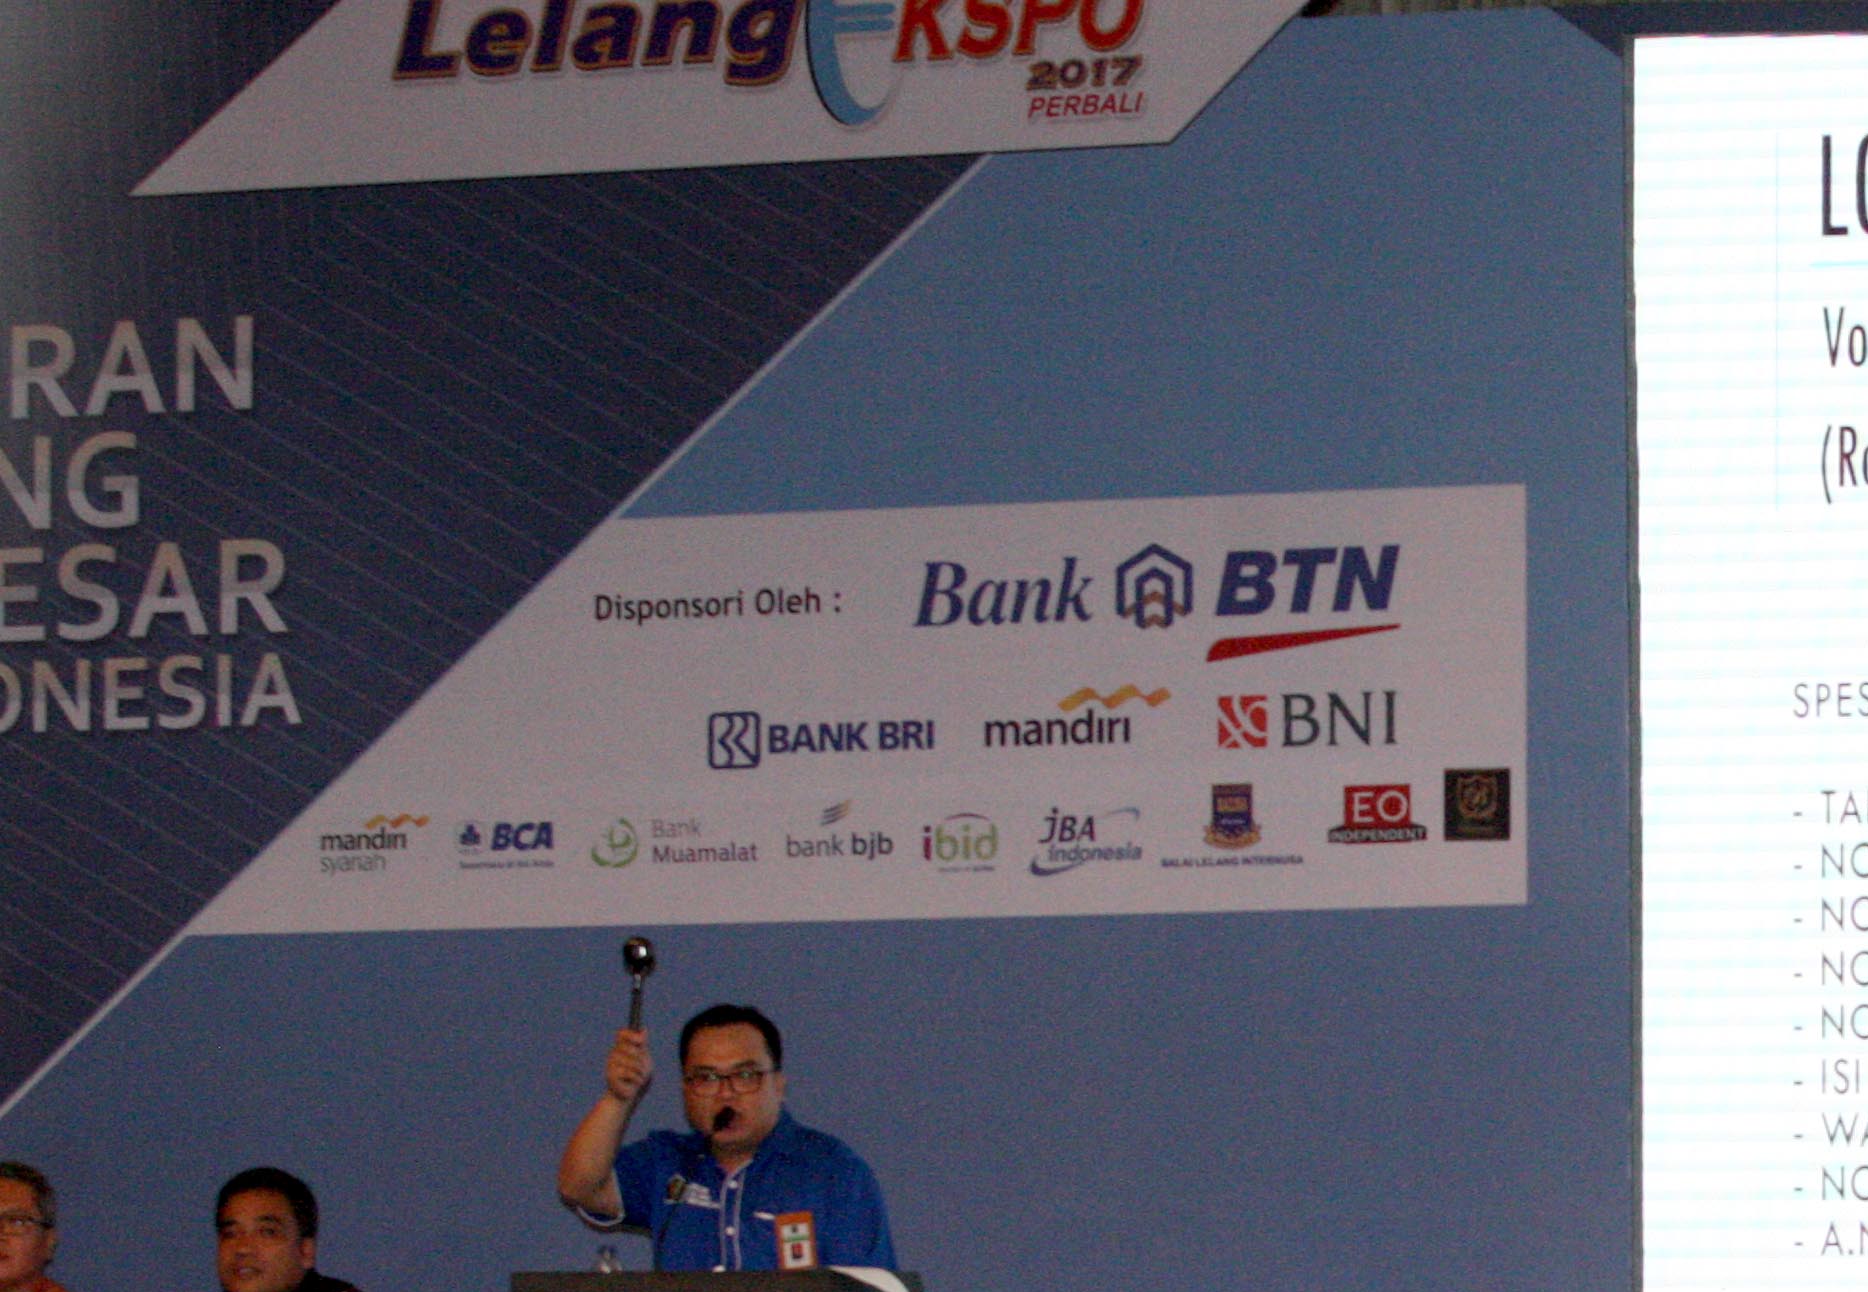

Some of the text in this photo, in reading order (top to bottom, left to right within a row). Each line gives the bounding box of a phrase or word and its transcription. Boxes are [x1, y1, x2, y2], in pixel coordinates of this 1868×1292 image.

[1027, 54, 1142, 91] 2017
[1028, 91, 1143, 119] PERBALI
[11, 314, 254, 420] RAN
[914, 545, 1400, 628] Bank BTN
[594, 590, 743, 626] Disponsori
[756, 588, 821, 615] Oleh
[985, 710, 1130, 747] mandiri
[1282, 690, 1396, 747] BNI
[769, 720, 934, 754] BANK BRI
[1352, 790, 1408, 823] EO
[320, 825, 407, 851] mandiri
[491, 822, 554, 850] BCA
[652, 819, 702, 839] Bank
[786, 832, 894, 860] bank bjb
[923, 824, 998, 862] ibid
[652, 843, 758, 864] Muamalat
[1823, 1060, 1858, 1094] ISI
